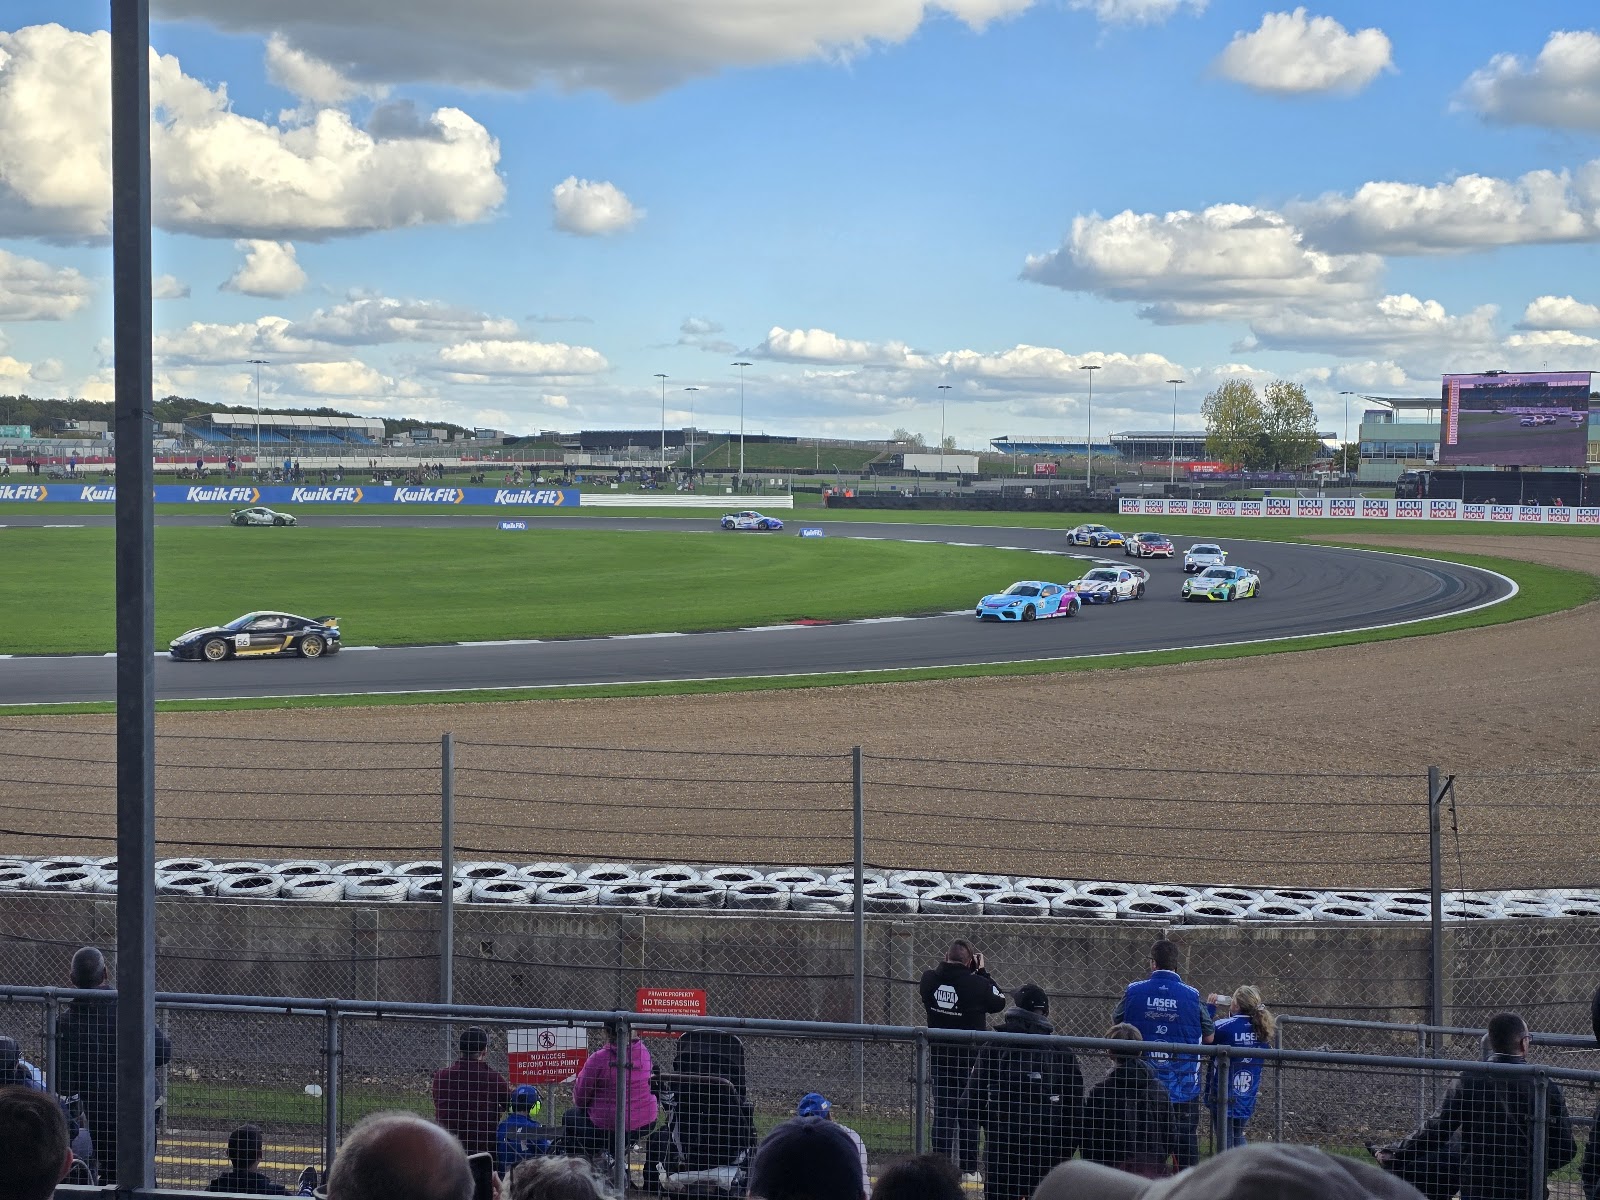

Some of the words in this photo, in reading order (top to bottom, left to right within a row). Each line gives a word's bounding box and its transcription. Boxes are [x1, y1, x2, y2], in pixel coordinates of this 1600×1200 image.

[1431, 501, 1456, 509] LIQUI
[1363, 508, 1388, 516] MOLY
[1396, 509, 1422, 517] MOLY
[1430, 510, 1456, 518] MOLY
[937, 990, 956, 1002] NAPA
[1147, 997, 1178, 1008] LASER
